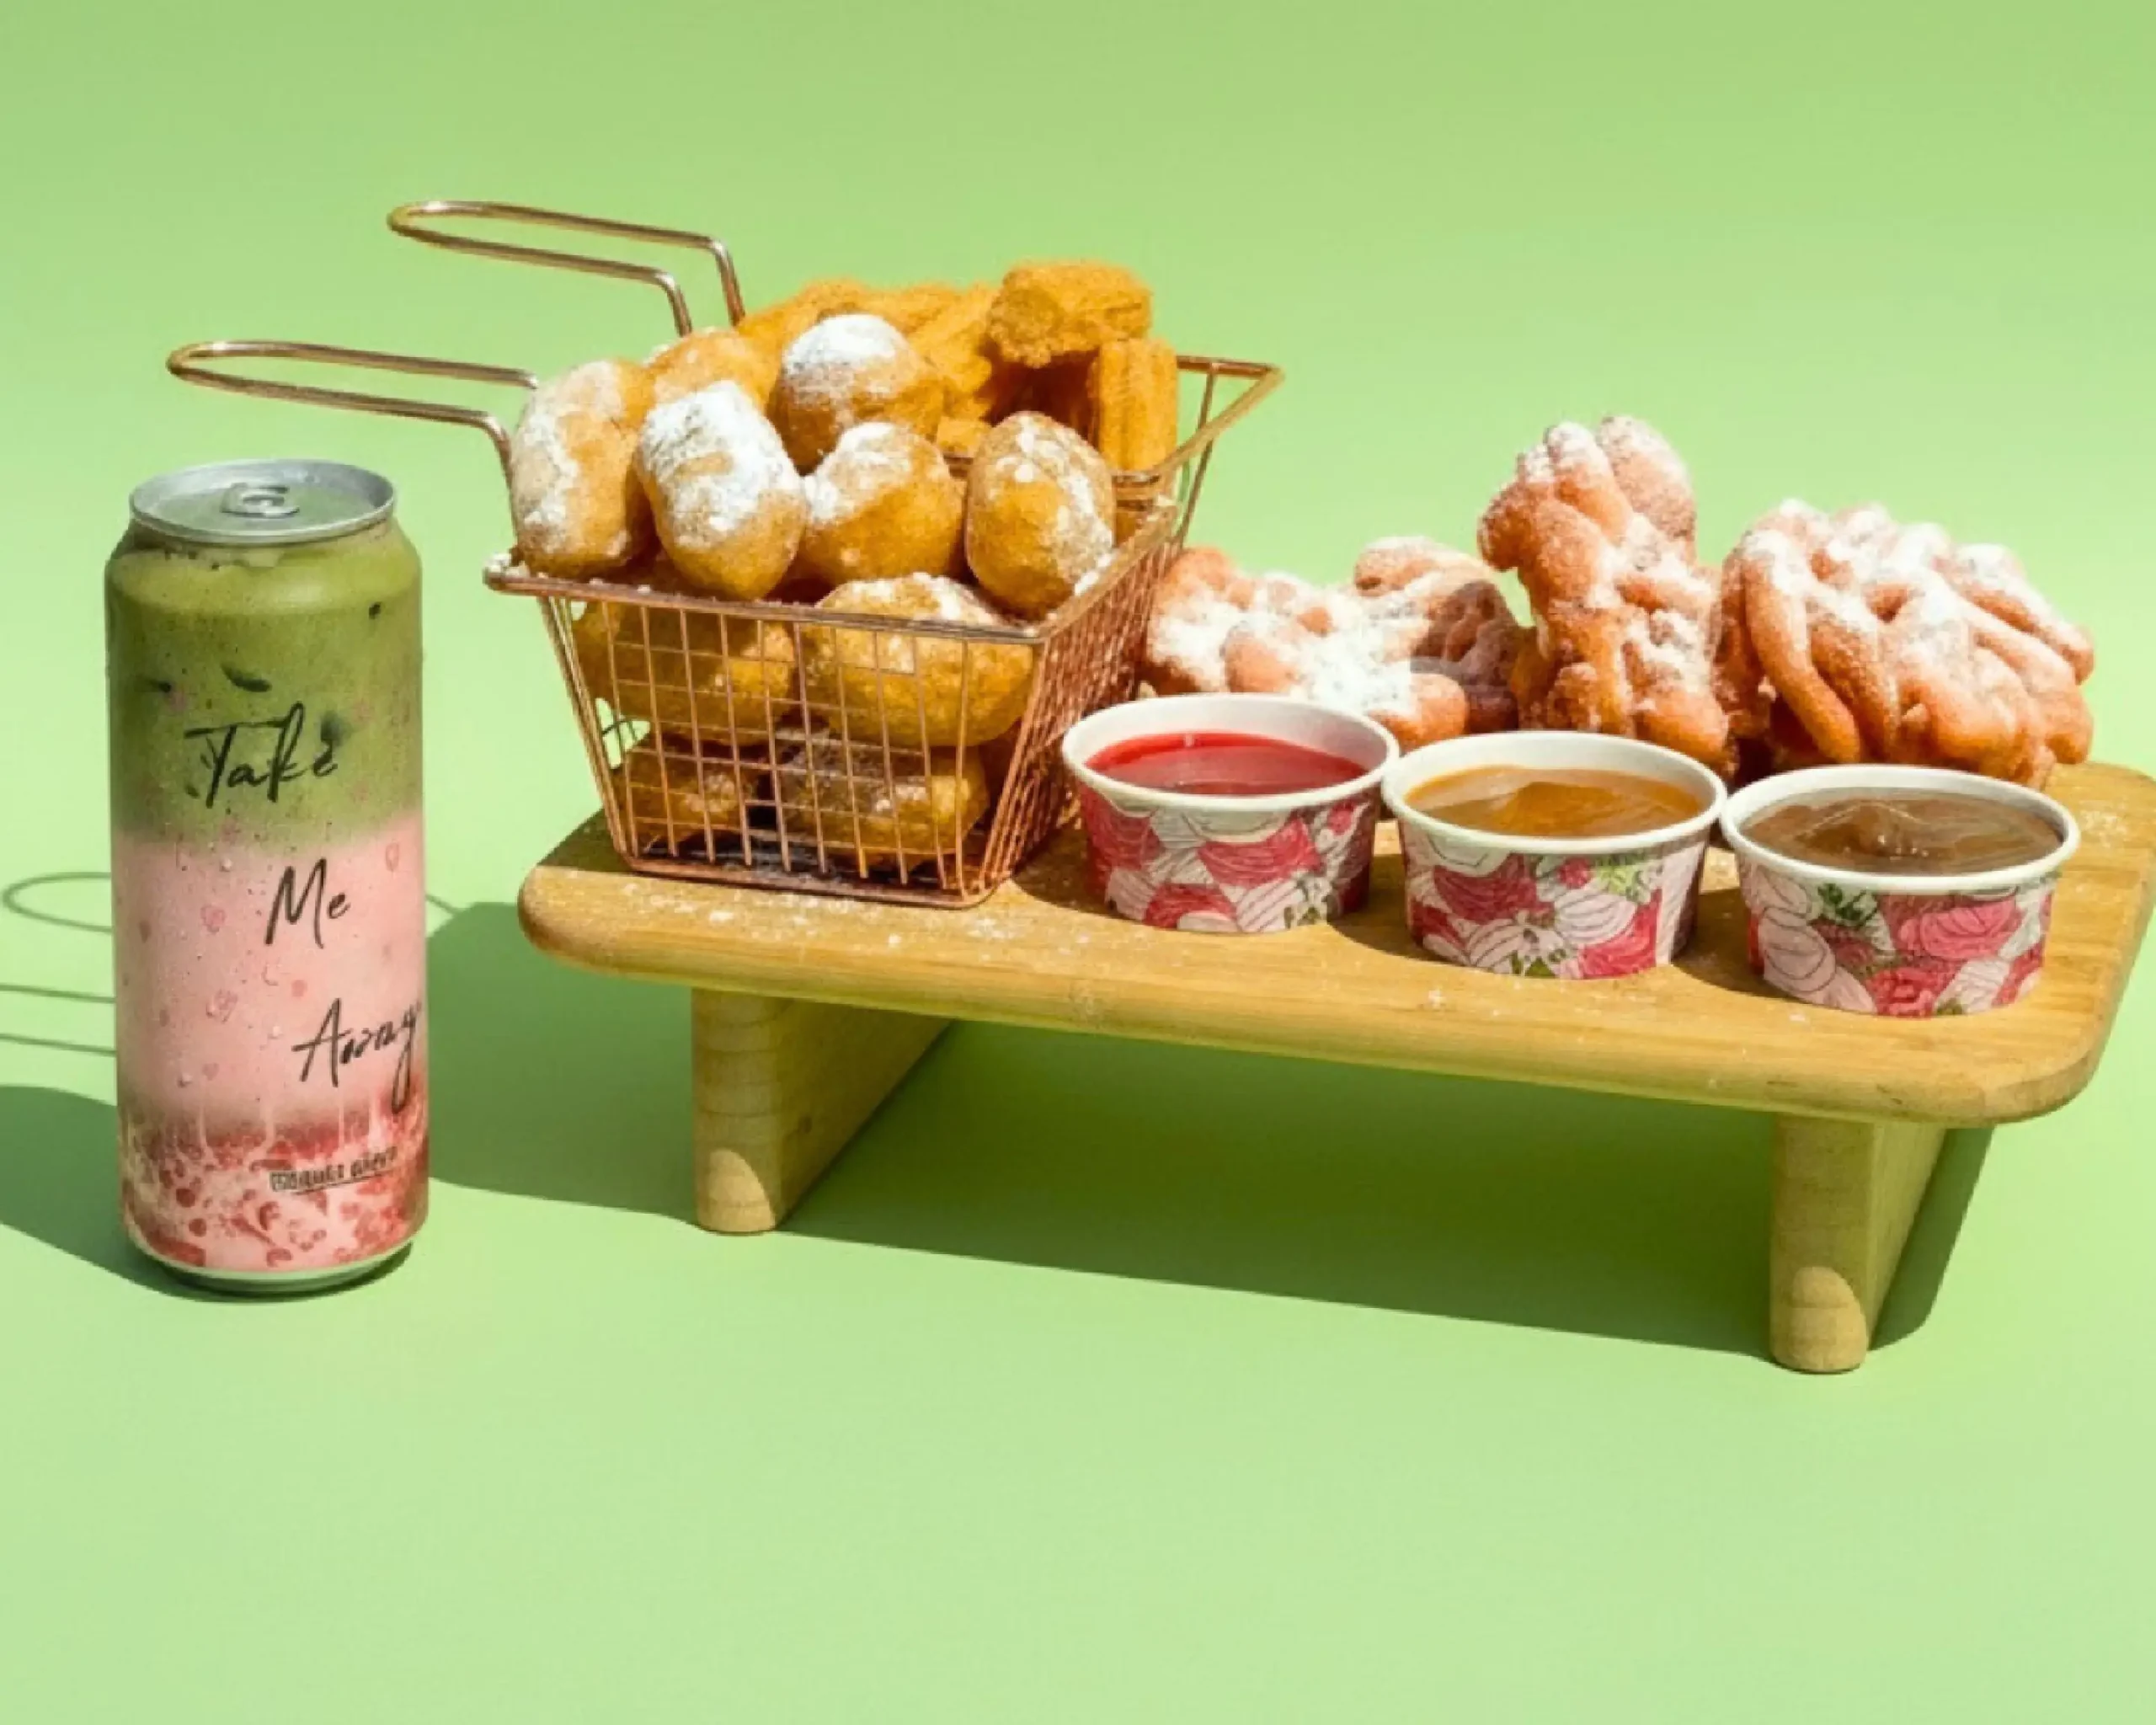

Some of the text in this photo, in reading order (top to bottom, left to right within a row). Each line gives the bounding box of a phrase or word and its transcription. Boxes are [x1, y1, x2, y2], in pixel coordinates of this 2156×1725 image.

[184, 701, 338, 809] Take
[264, 857, 350, 948] Me
[291, 997, 421, 1114] Away
